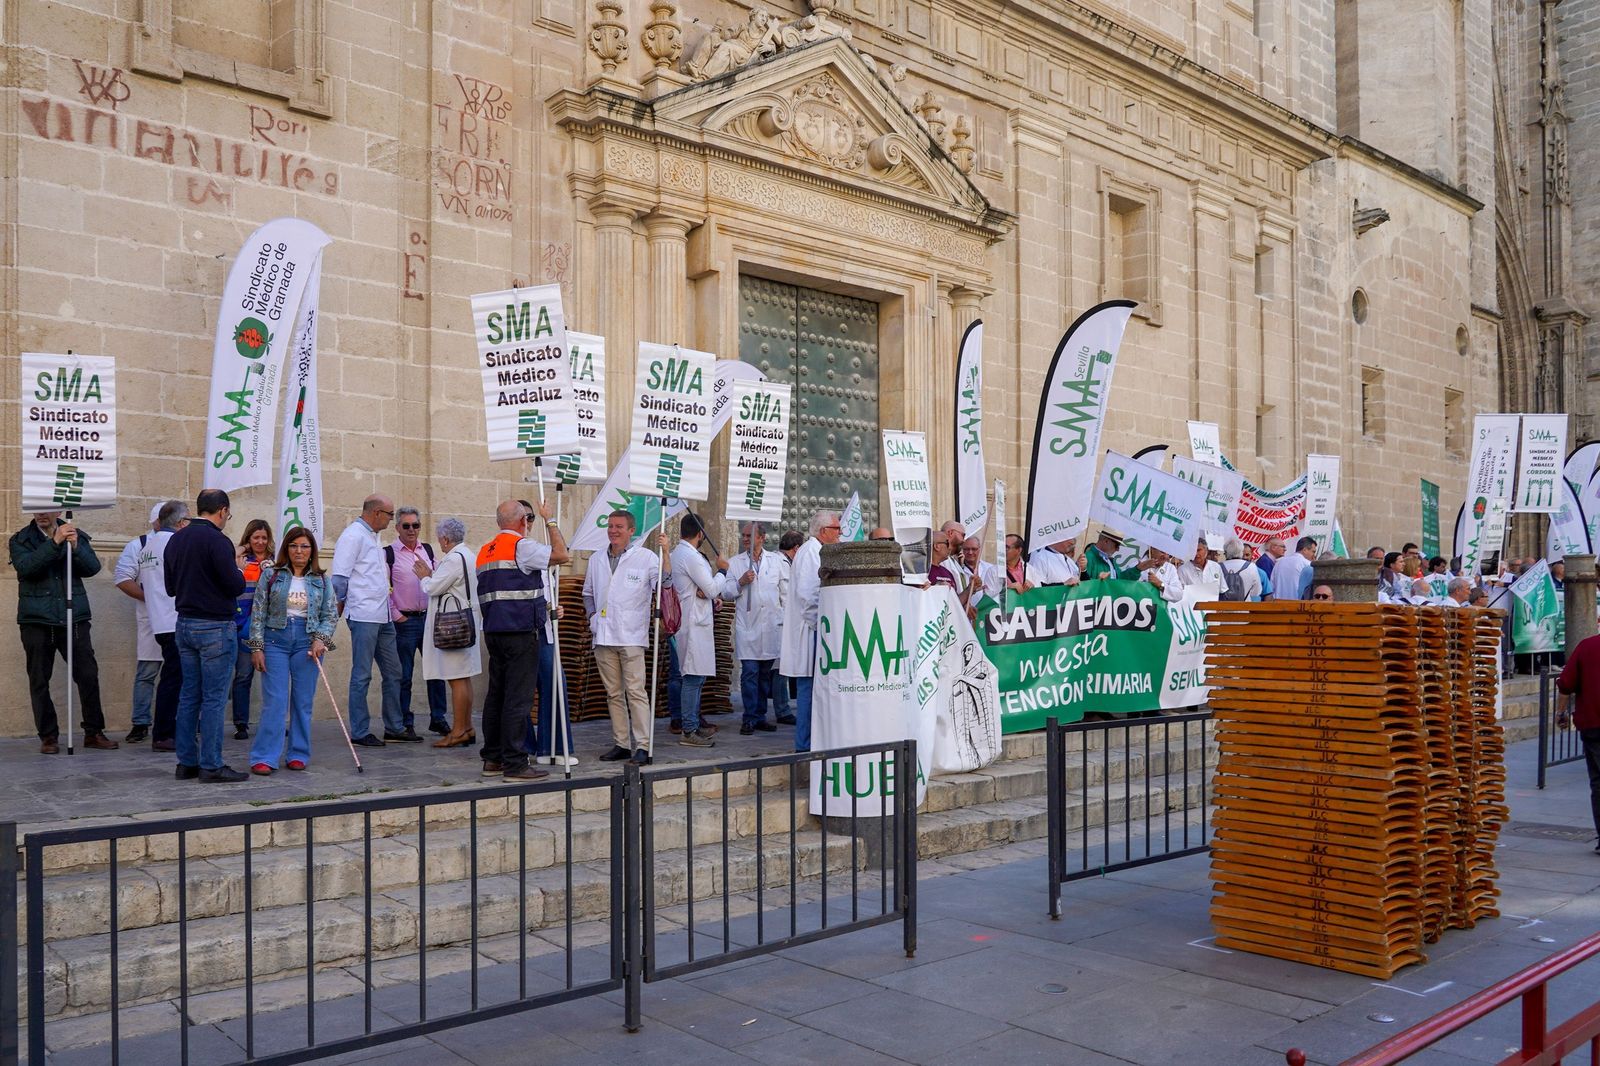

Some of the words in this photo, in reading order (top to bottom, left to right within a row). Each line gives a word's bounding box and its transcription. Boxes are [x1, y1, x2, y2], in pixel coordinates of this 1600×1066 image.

[241, 243, 272, 311] Sindicato
[254, 263, 280, 316] Médico
[274, 242, 288, 261] de
[268, 261, 296, 321] Granada
[487, 302, 553, 344] SMA
[486, 345, 562, 368] Sindicato
[1075, 345, 1090, 380] Sevilla
[34, 367, 102, 403] SMA
[255, 374, 267, 405] Andaluz
[263, 363, 277, 406] Granada
[497, 368, 556, 387] Médico
[646, 357, 703, 396] SMA
[713, 378, 726, 393] de
[497, 387, 562, 407] Andaluz
[640, 394, 707, 417] Sindicato
[739, 392, 782, 423] SMA
[1049, 355, 1101, 458] SMA
[29, 406, 109, 424] Sindicato
[213, 365, 254, 469] SMA
[251, 405, 262, 433] Médico
[647, 414, 698, 434] Médico
[39, 426, 100, 442] Médico
[308, 418, 317, 464] Granada
[642, 432, 700, 452] Andaluz
[735, 424, 784, 440] Sindicato
[36, 445, 104, 461] Andaluz
[250, 433, 258, 468] Sindicato
[740, 440, 778, 455] Médico
[886, 439, 920, 458] SMA
[737, 455, 779, 470] Andaluz
[305, 465, 313, 496] Médico
[892, 480, 928, 491] HUELVA
[1103, 466, 1183, 526] SMA
[307, 498, 318, 533] Sindicato
[1165, 502, 1192, 520] Sevilla
[1037, 516, 1081, 537] SEVILLA
[819, 606, 909, 683] SMA
[838, 683, 875, 692] Sindicato
[877, 682, 902, 691] Médico
[1000, 677, 1084, 715] TENCIÓN
[1086, 672, 1153, 695] RIMARIA
